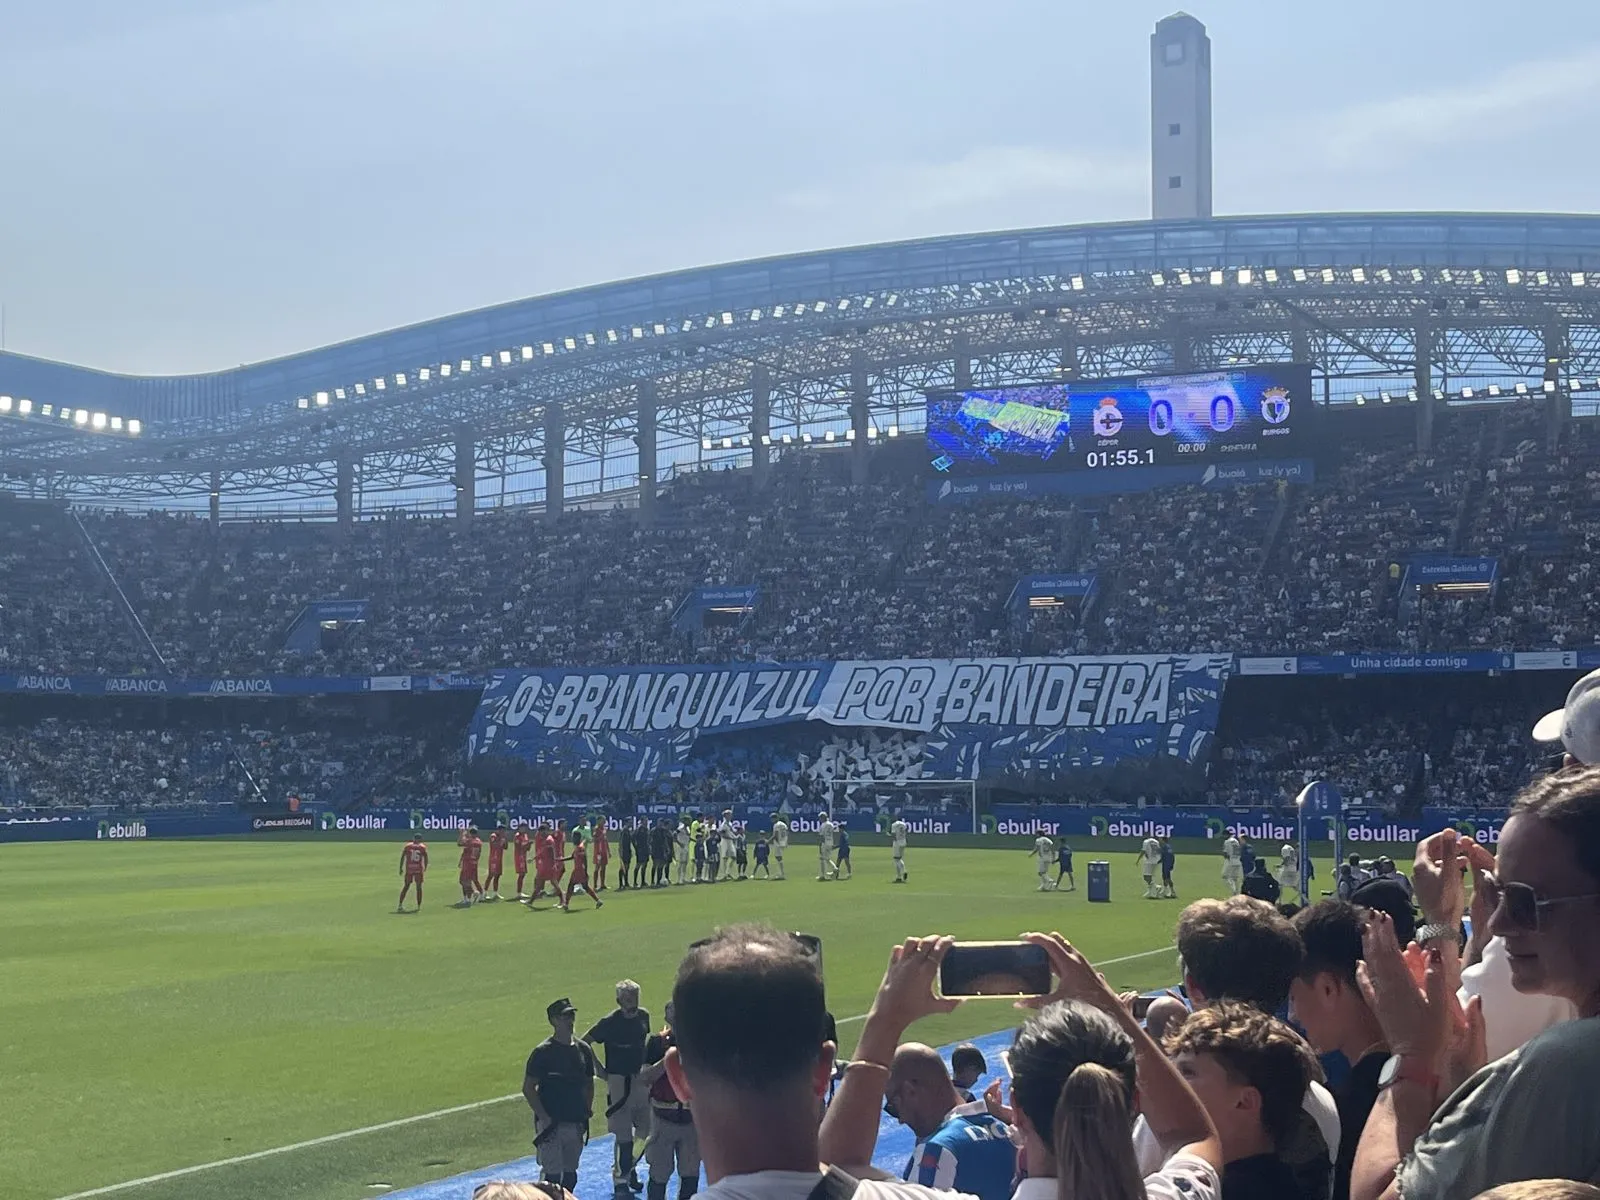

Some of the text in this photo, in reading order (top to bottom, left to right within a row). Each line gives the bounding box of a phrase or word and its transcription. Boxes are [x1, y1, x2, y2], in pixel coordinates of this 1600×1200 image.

[1148, 395, 1235, 436] 0 0
[1086, 448, 1155, 468] 01:55.1
[1351, 655, 1468, 669] Unha cidade contigo
[22, 676, 72, 691] ABANCA
[110, 679, 168, 692] ABANCA
[216, 679, 272, 693] ABANCA
[544, 669, 819, 731] BRANQUIAZUL
[834, 666, 936, 724] POR
[942, 661, 1174, 727] BANDEIRA
